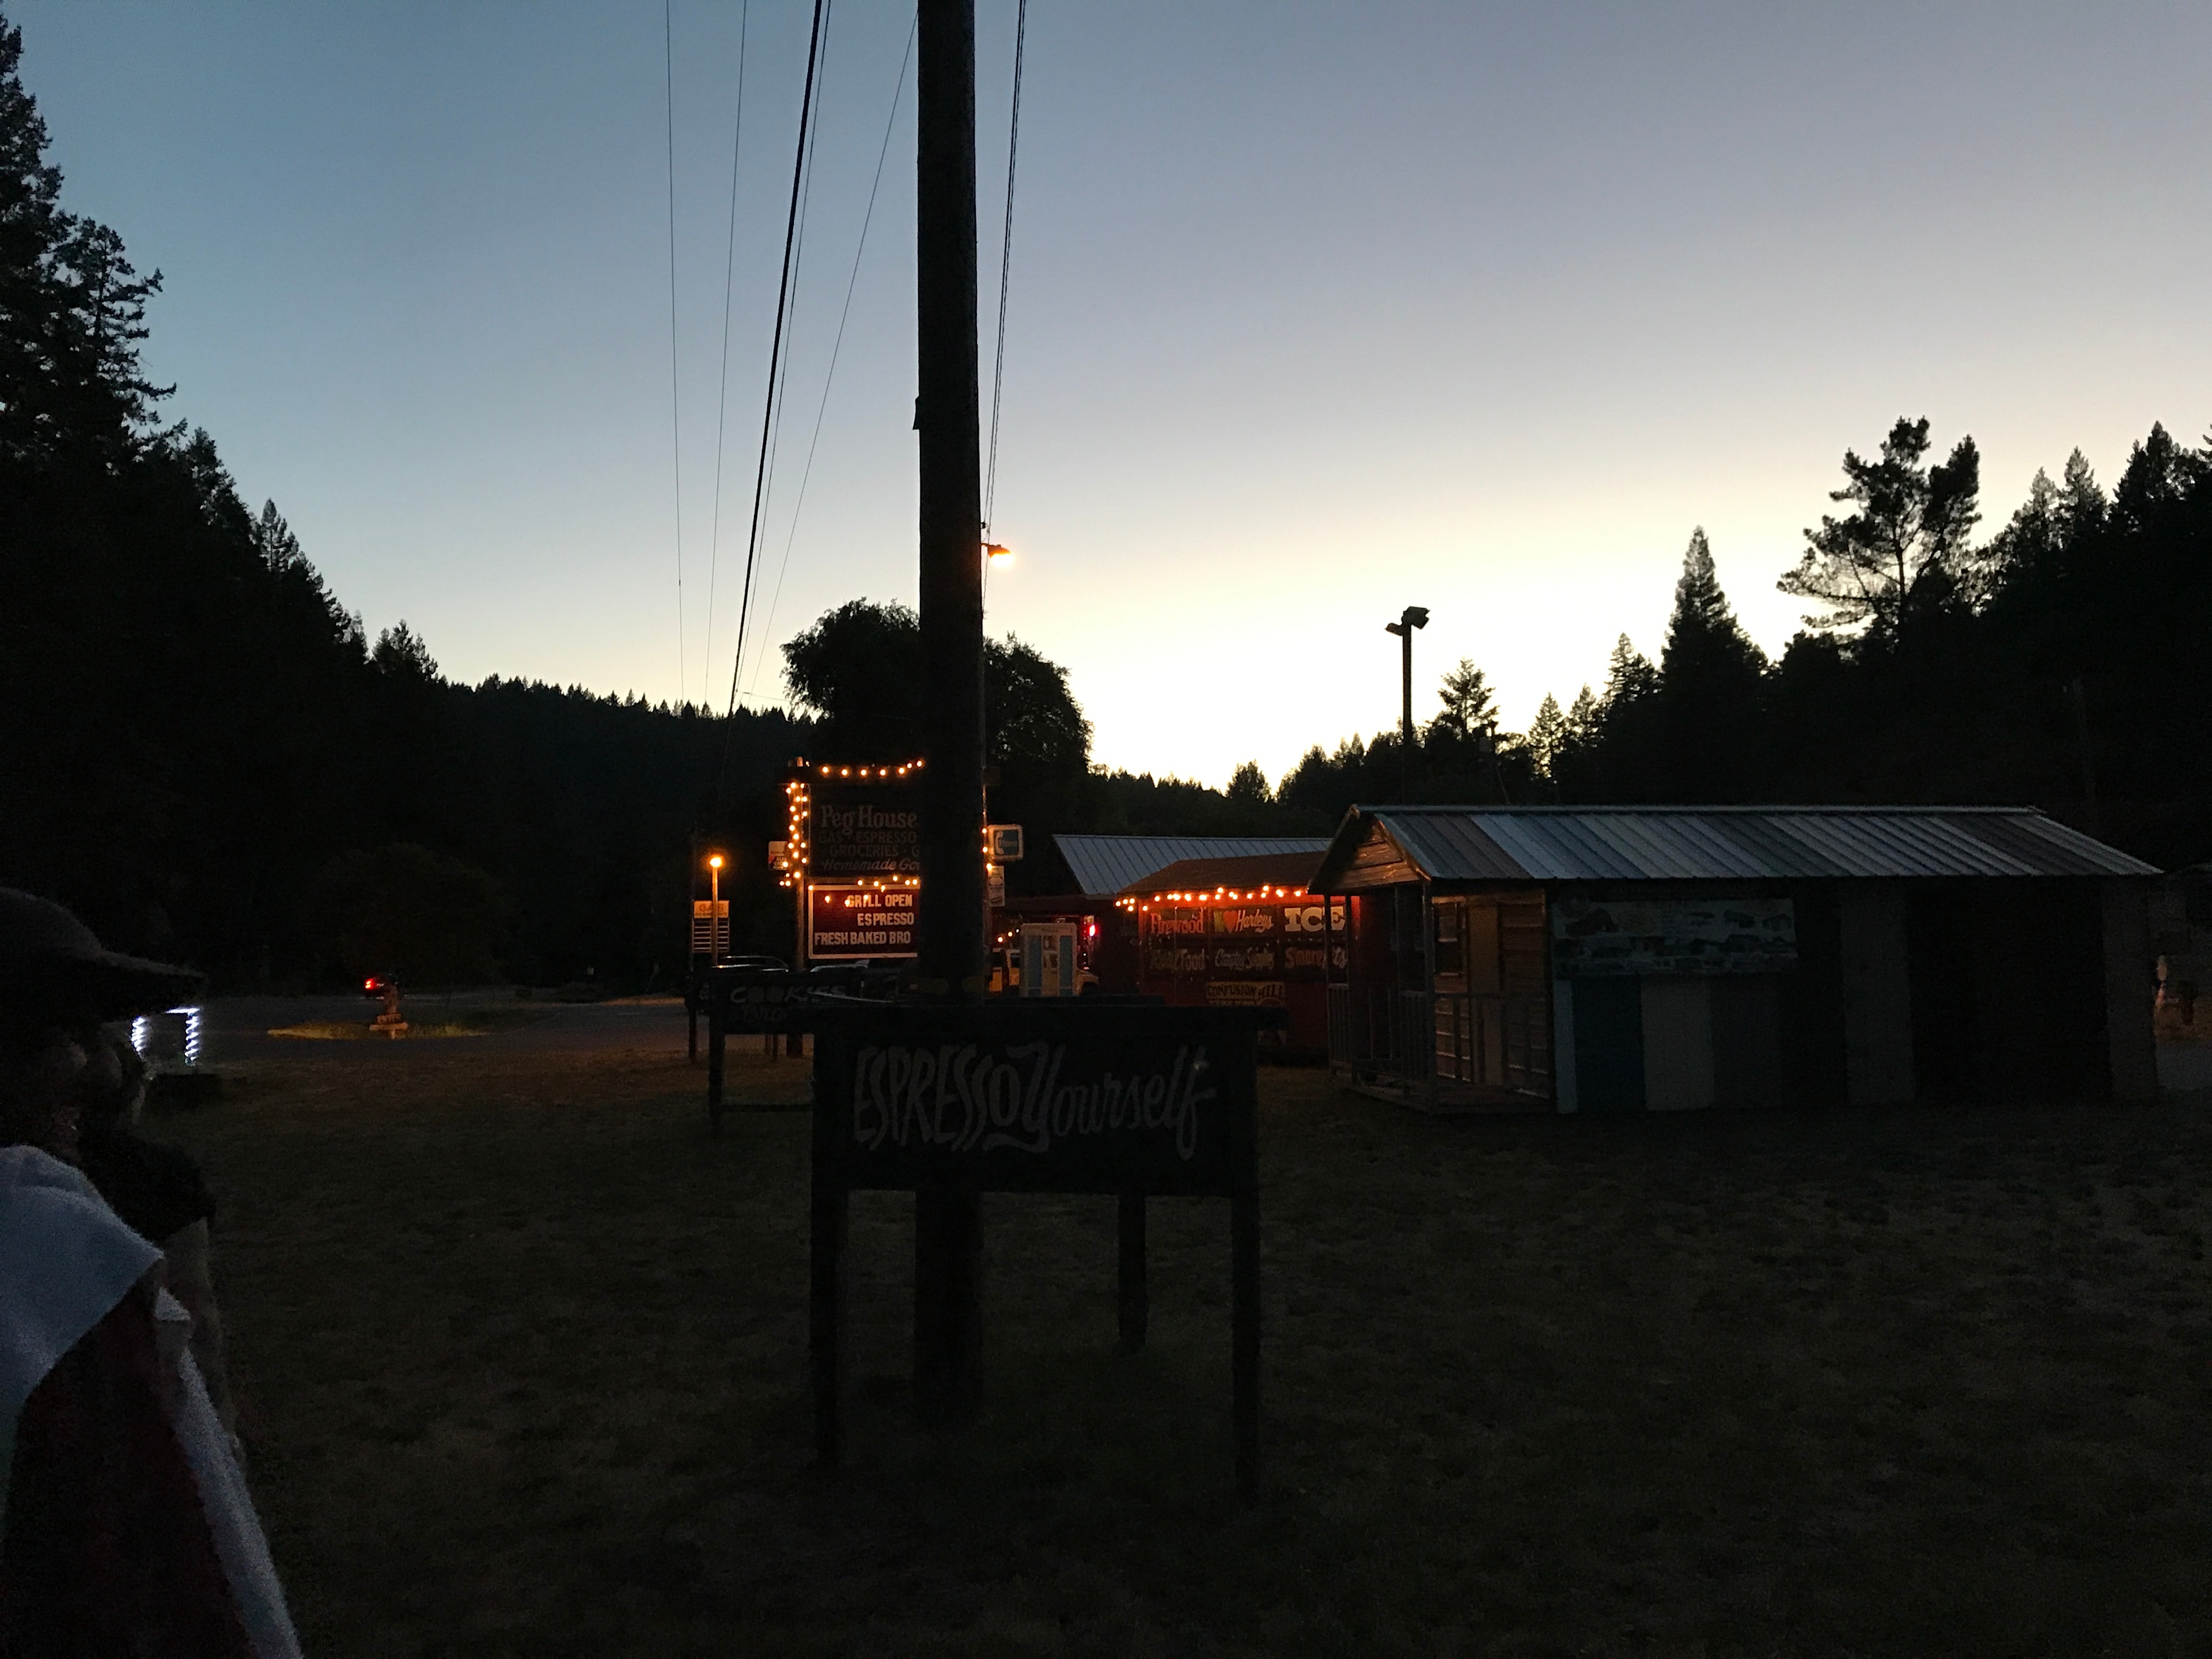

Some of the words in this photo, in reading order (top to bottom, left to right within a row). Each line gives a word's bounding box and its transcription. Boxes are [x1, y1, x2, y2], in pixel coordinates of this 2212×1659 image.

[820, 805, 853, 835] Peg
[857, 805, 917, 828] House
[819, 830, 842, 844] GAS
[856, 831, 917, 844] ESPRESSO
[830, 844, 899, 858] GROCERIES
[821, 858, 897, 870] Homemade
[846, 893, 882, 908] GRILL
[884, 893, 913, 907] OPEN
[857, 912, 915, 927] ESPRESSO
[1150, 908, 1205, 934] Firewood
[1234, 908, 1275, 933] Harleys
[1284, 906, 1346, 932] ICE
[814, 931, 849, 945] FRESH
[850, 931, 887, 945] BAKED
[1207, 983, 1256, 997] CONFUSION
[854, 1043, 1021, 1152] ESPRESSO
[983, 1040, 1217, 1161] Yourself
